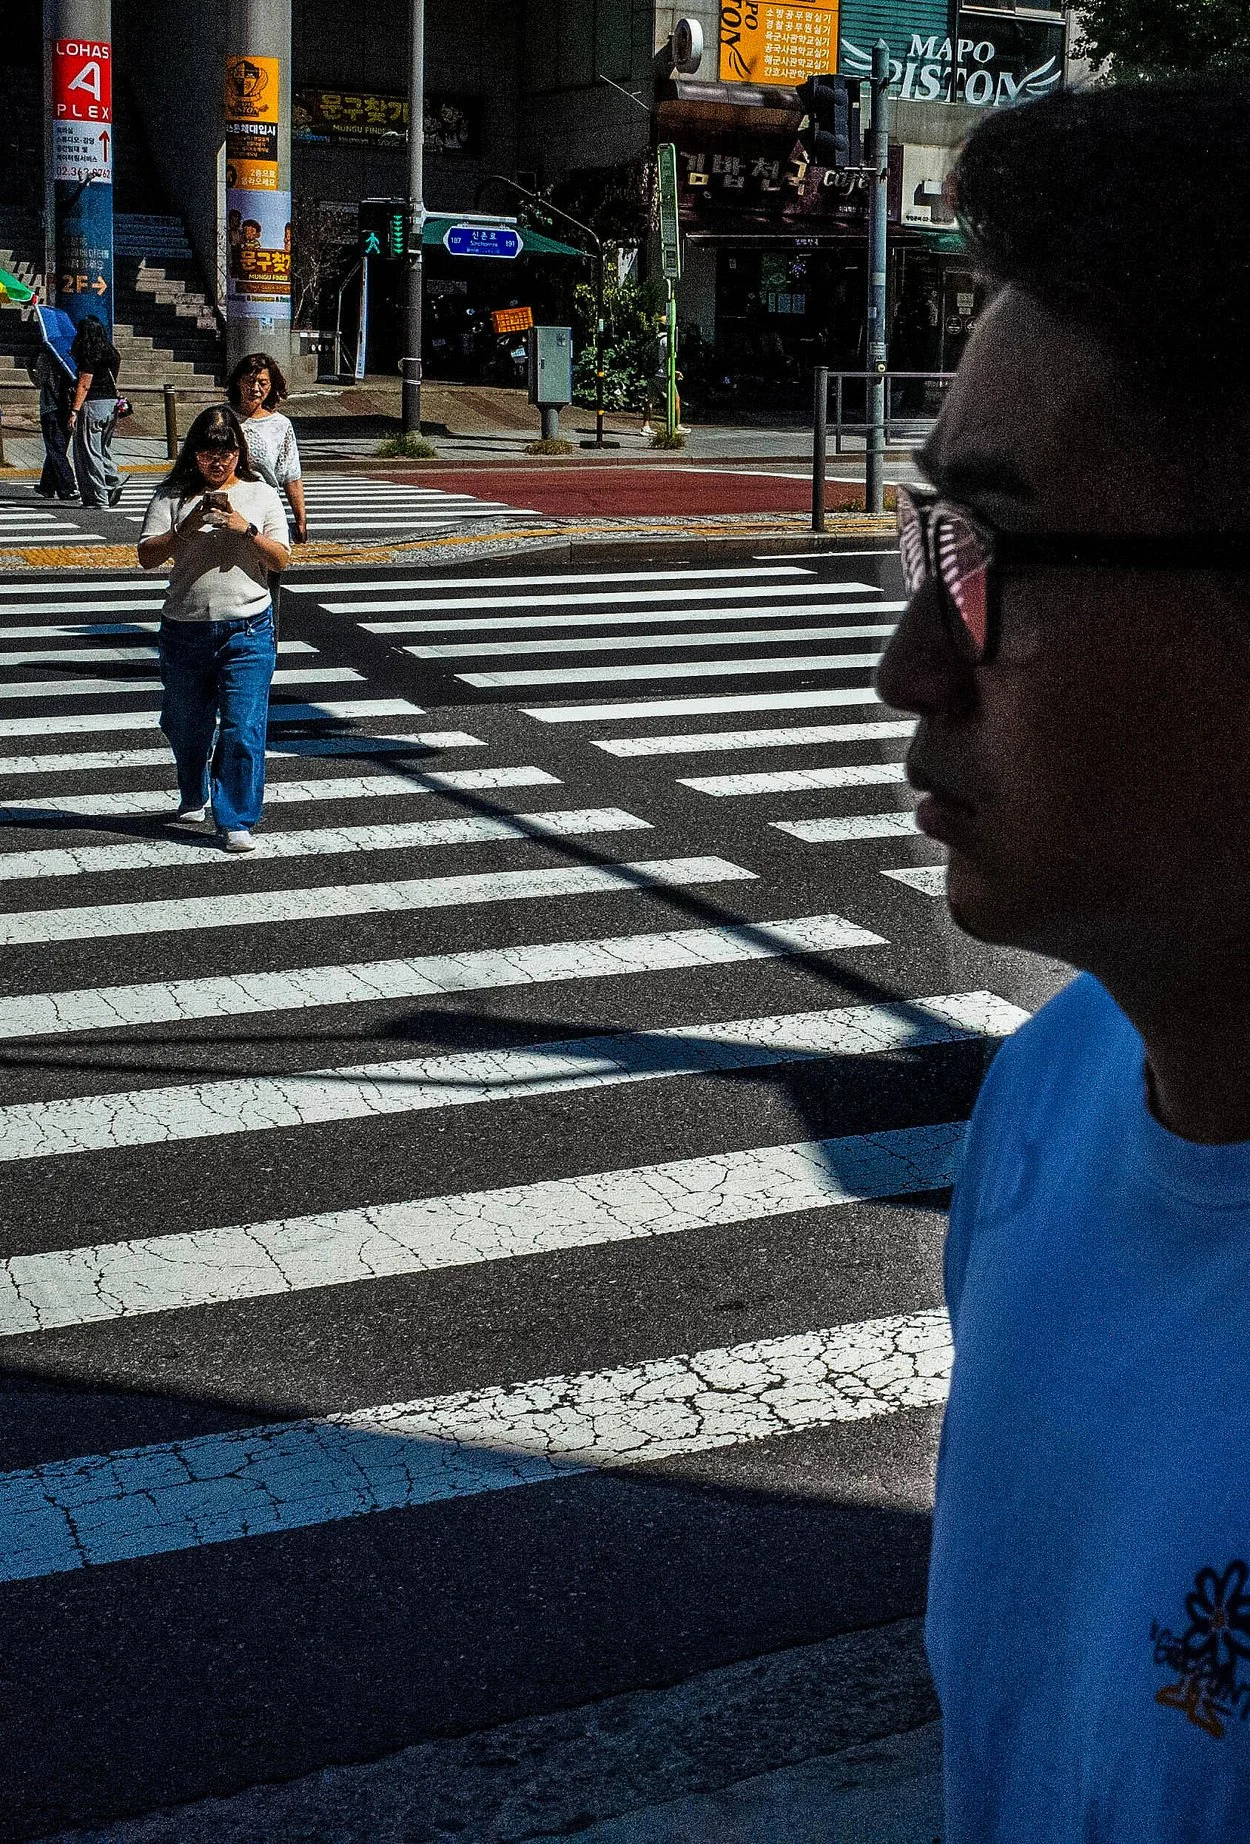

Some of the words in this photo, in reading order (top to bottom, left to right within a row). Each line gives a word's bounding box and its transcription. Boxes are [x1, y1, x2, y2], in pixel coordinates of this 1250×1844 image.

[56, 42, 109, 59] LOHAS
[907, 34, 995, 64] MAPO
[472, 231, 497, 241] 신촌로
[62, 274, 88, 293] 2F
